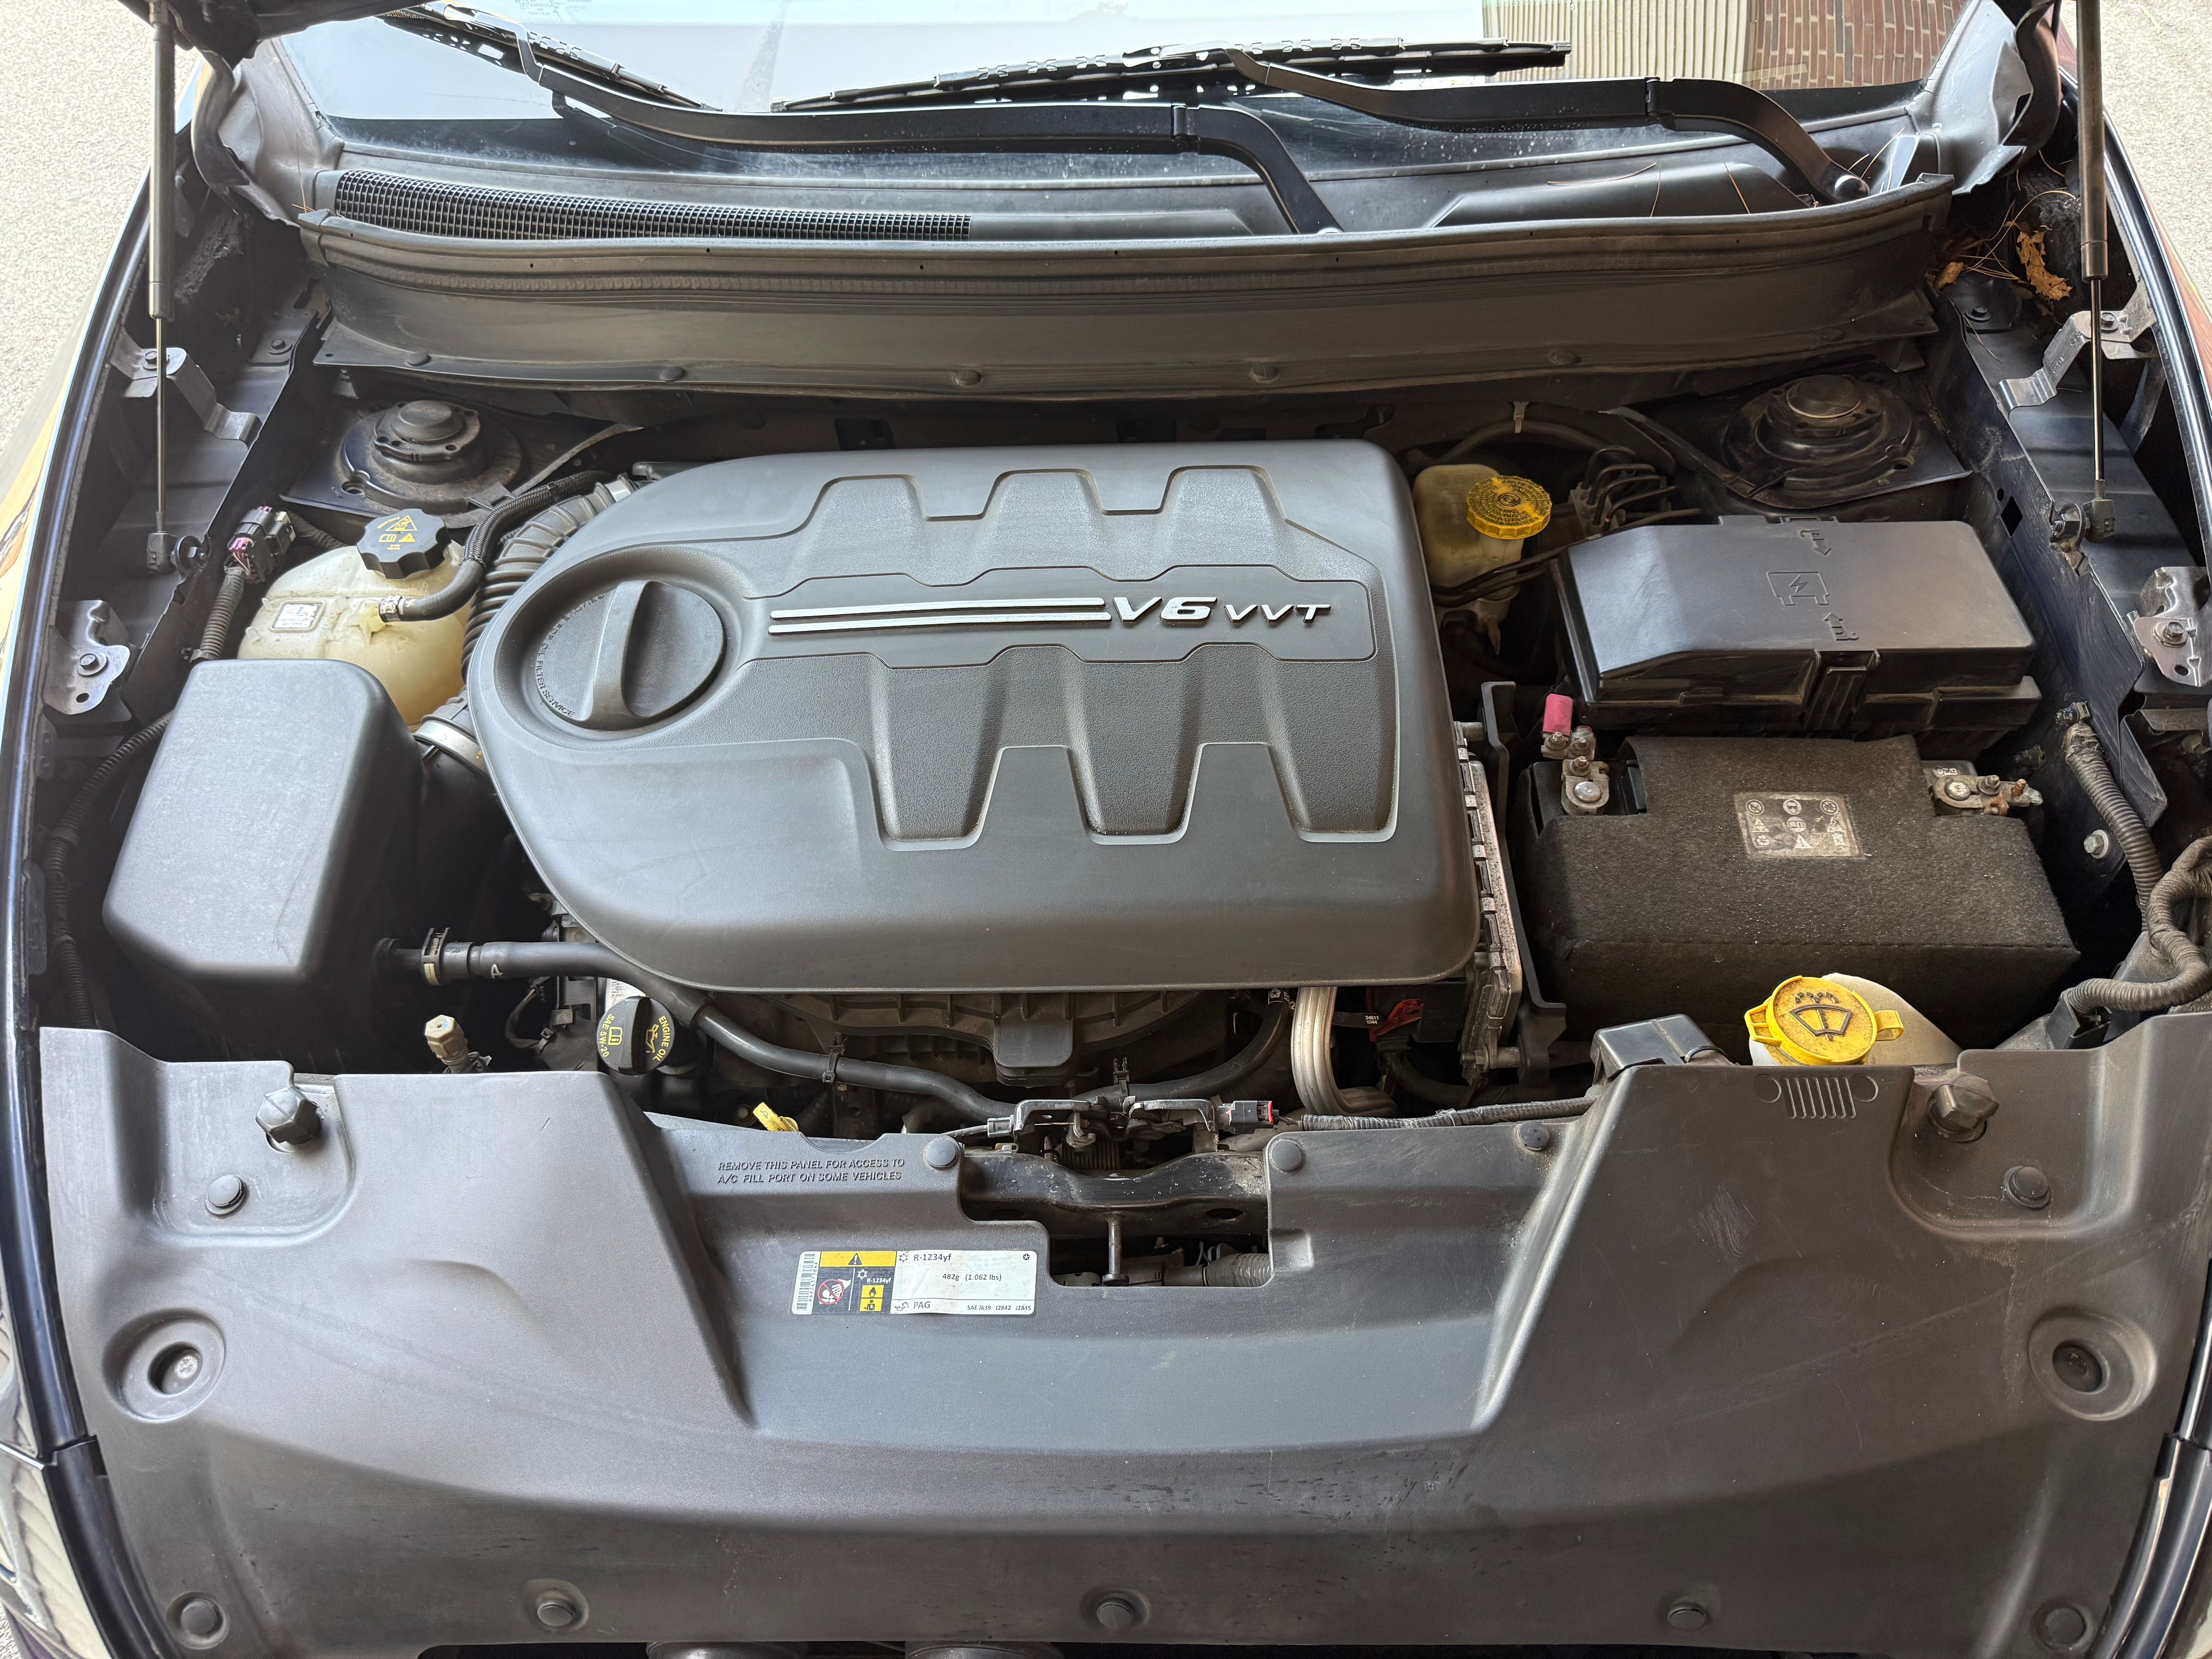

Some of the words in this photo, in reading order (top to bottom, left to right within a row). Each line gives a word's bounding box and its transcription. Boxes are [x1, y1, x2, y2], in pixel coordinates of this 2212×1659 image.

[1113, 597, 1217, 623] V6
[1225, 604, 1331, 624] VVT
[538, 643, 549, 657] OIL
[536, 660, 546, 689] FILTER
[542, 690, 576, 717] SERVICE
[602, 1013, 615, 1030] SAE
[659, 1016, 670, 1048] ENGINE
[599, 1031, 610, 1058] 5W-20
[653, 1049, 666, 1061] OIL
[718, 1161, 761, 1170] REMOVE
[764, 1161, 788, 1169] THIS
[790, 1160, 823, 1169] PANEL
[826, 1160, 846, 1168] FOR
[848, 1159, 888, 1168] ACCESS
[891, 1159, 905, 1167] TO
[717, 1174, 738, 1183] A/C
[743, 1174, 764, 1183] FILL
[768, 1173, 795, 1182] PORT
[799, 1173, 815, 1182] ON
[818, 1172, 848, 1181] SOME
[852, 1171, 902, 1181] VEHICLES
[914, 1254, 952, 1262] R-1234yf
